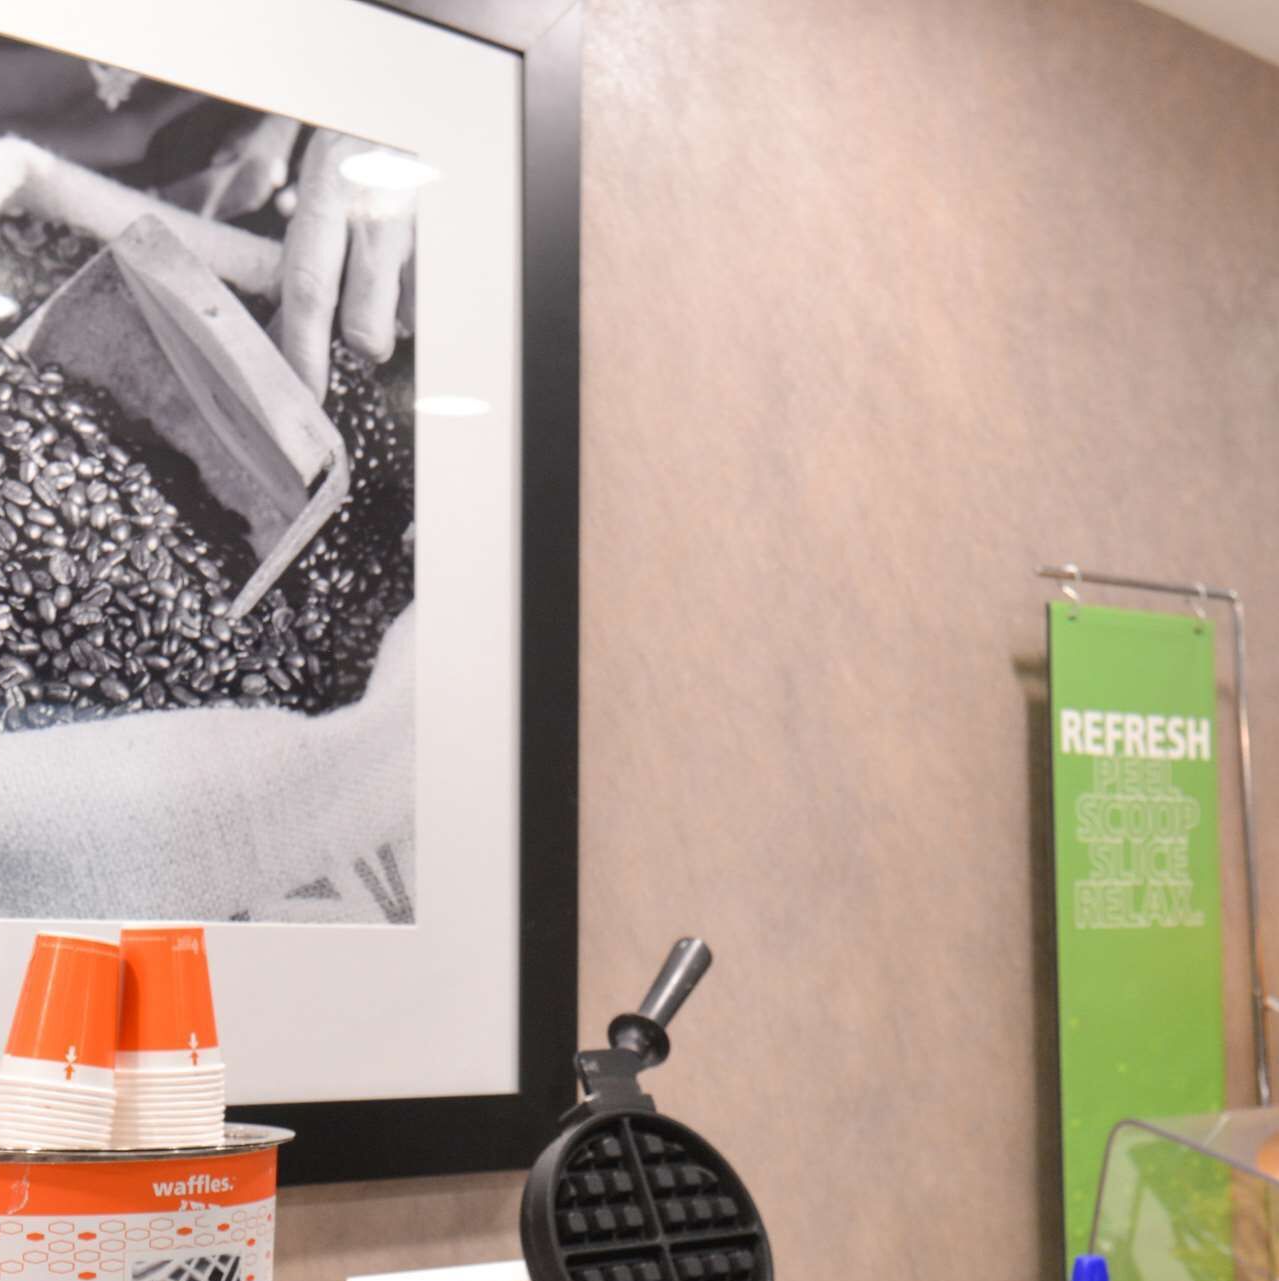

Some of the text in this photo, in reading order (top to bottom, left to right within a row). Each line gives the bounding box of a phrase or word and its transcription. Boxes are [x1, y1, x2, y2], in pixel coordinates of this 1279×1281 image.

[1059, 708, 1211, 761] REFRESH
[1074, 795, 1201, 845] SCOOP
[1087, 837, 1190, 882] SLICE
[152, 1173, 234, 1198] waffles.
